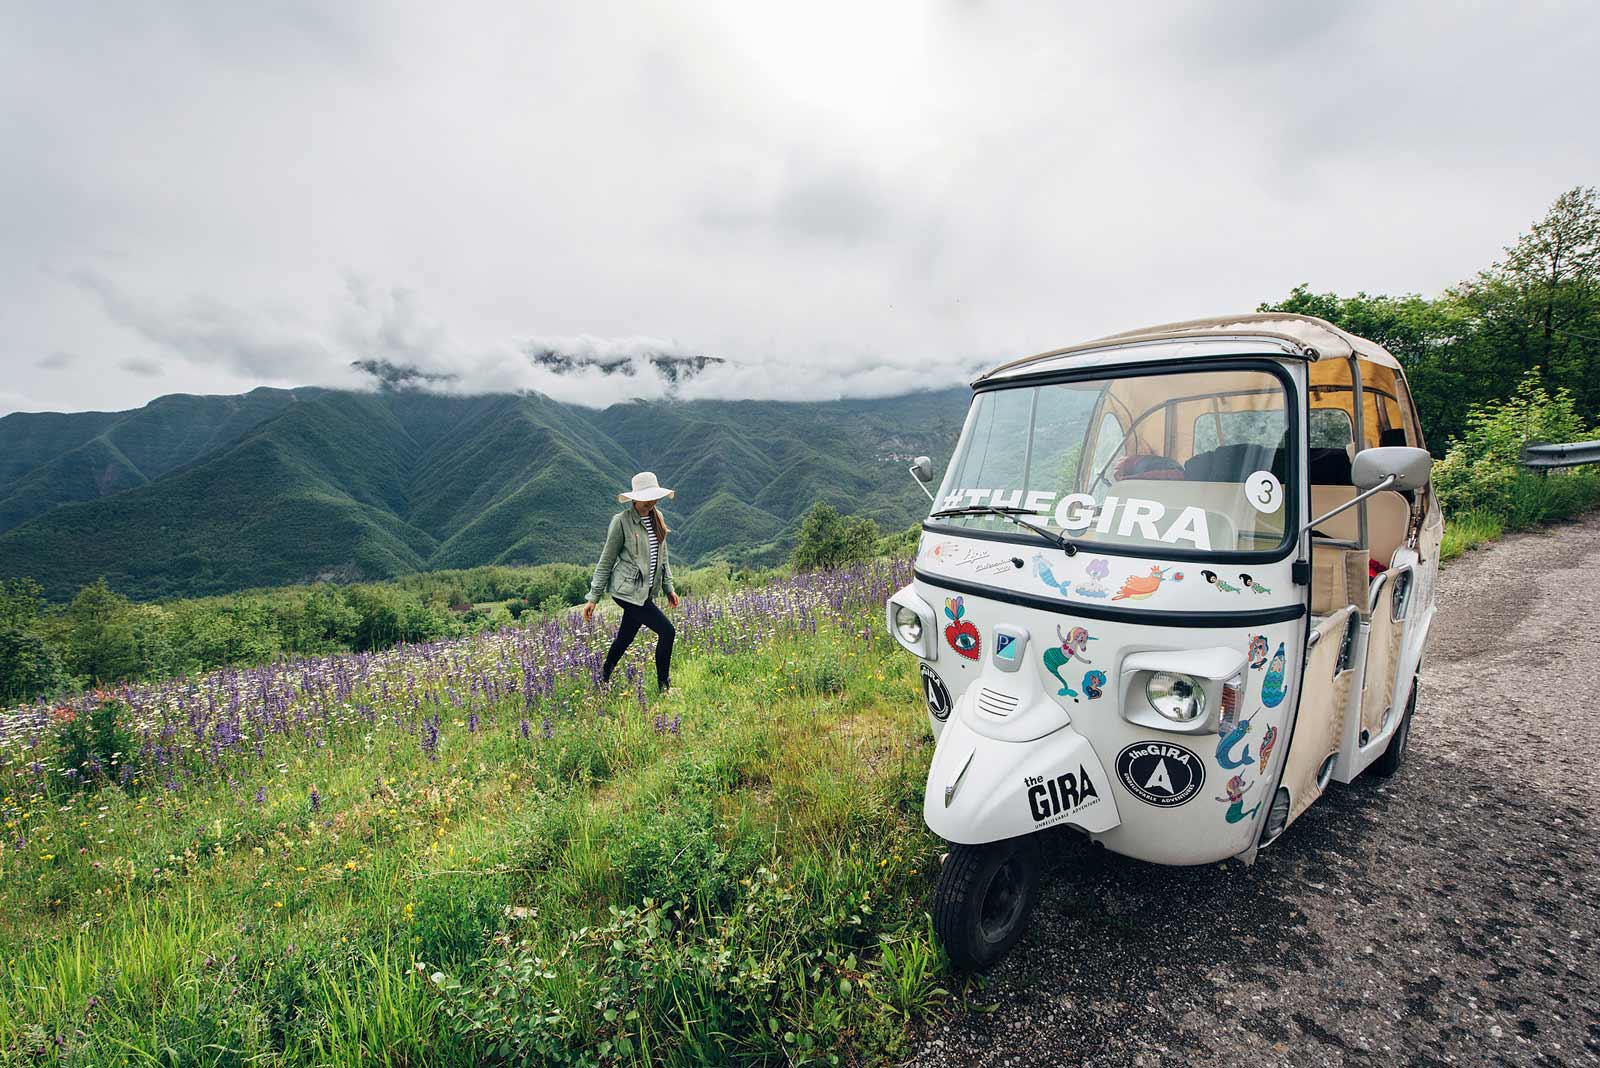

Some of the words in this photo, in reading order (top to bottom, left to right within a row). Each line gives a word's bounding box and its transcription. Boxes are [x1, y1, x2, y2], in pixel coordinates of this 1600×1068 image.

[1258, 479, 1274, 505] 3
[942, 488, 1212, 551] #THEGIRA
[1023, 775, 1044, 788] the
[1027, 762, 1099, 822] GIRA
[1161, 784, 1196, 803] ADVENTURES
[1034, 812, 1070, 830] UNBELIEVABLE
[1072, 798, 1102, 815] ADVENTURES
